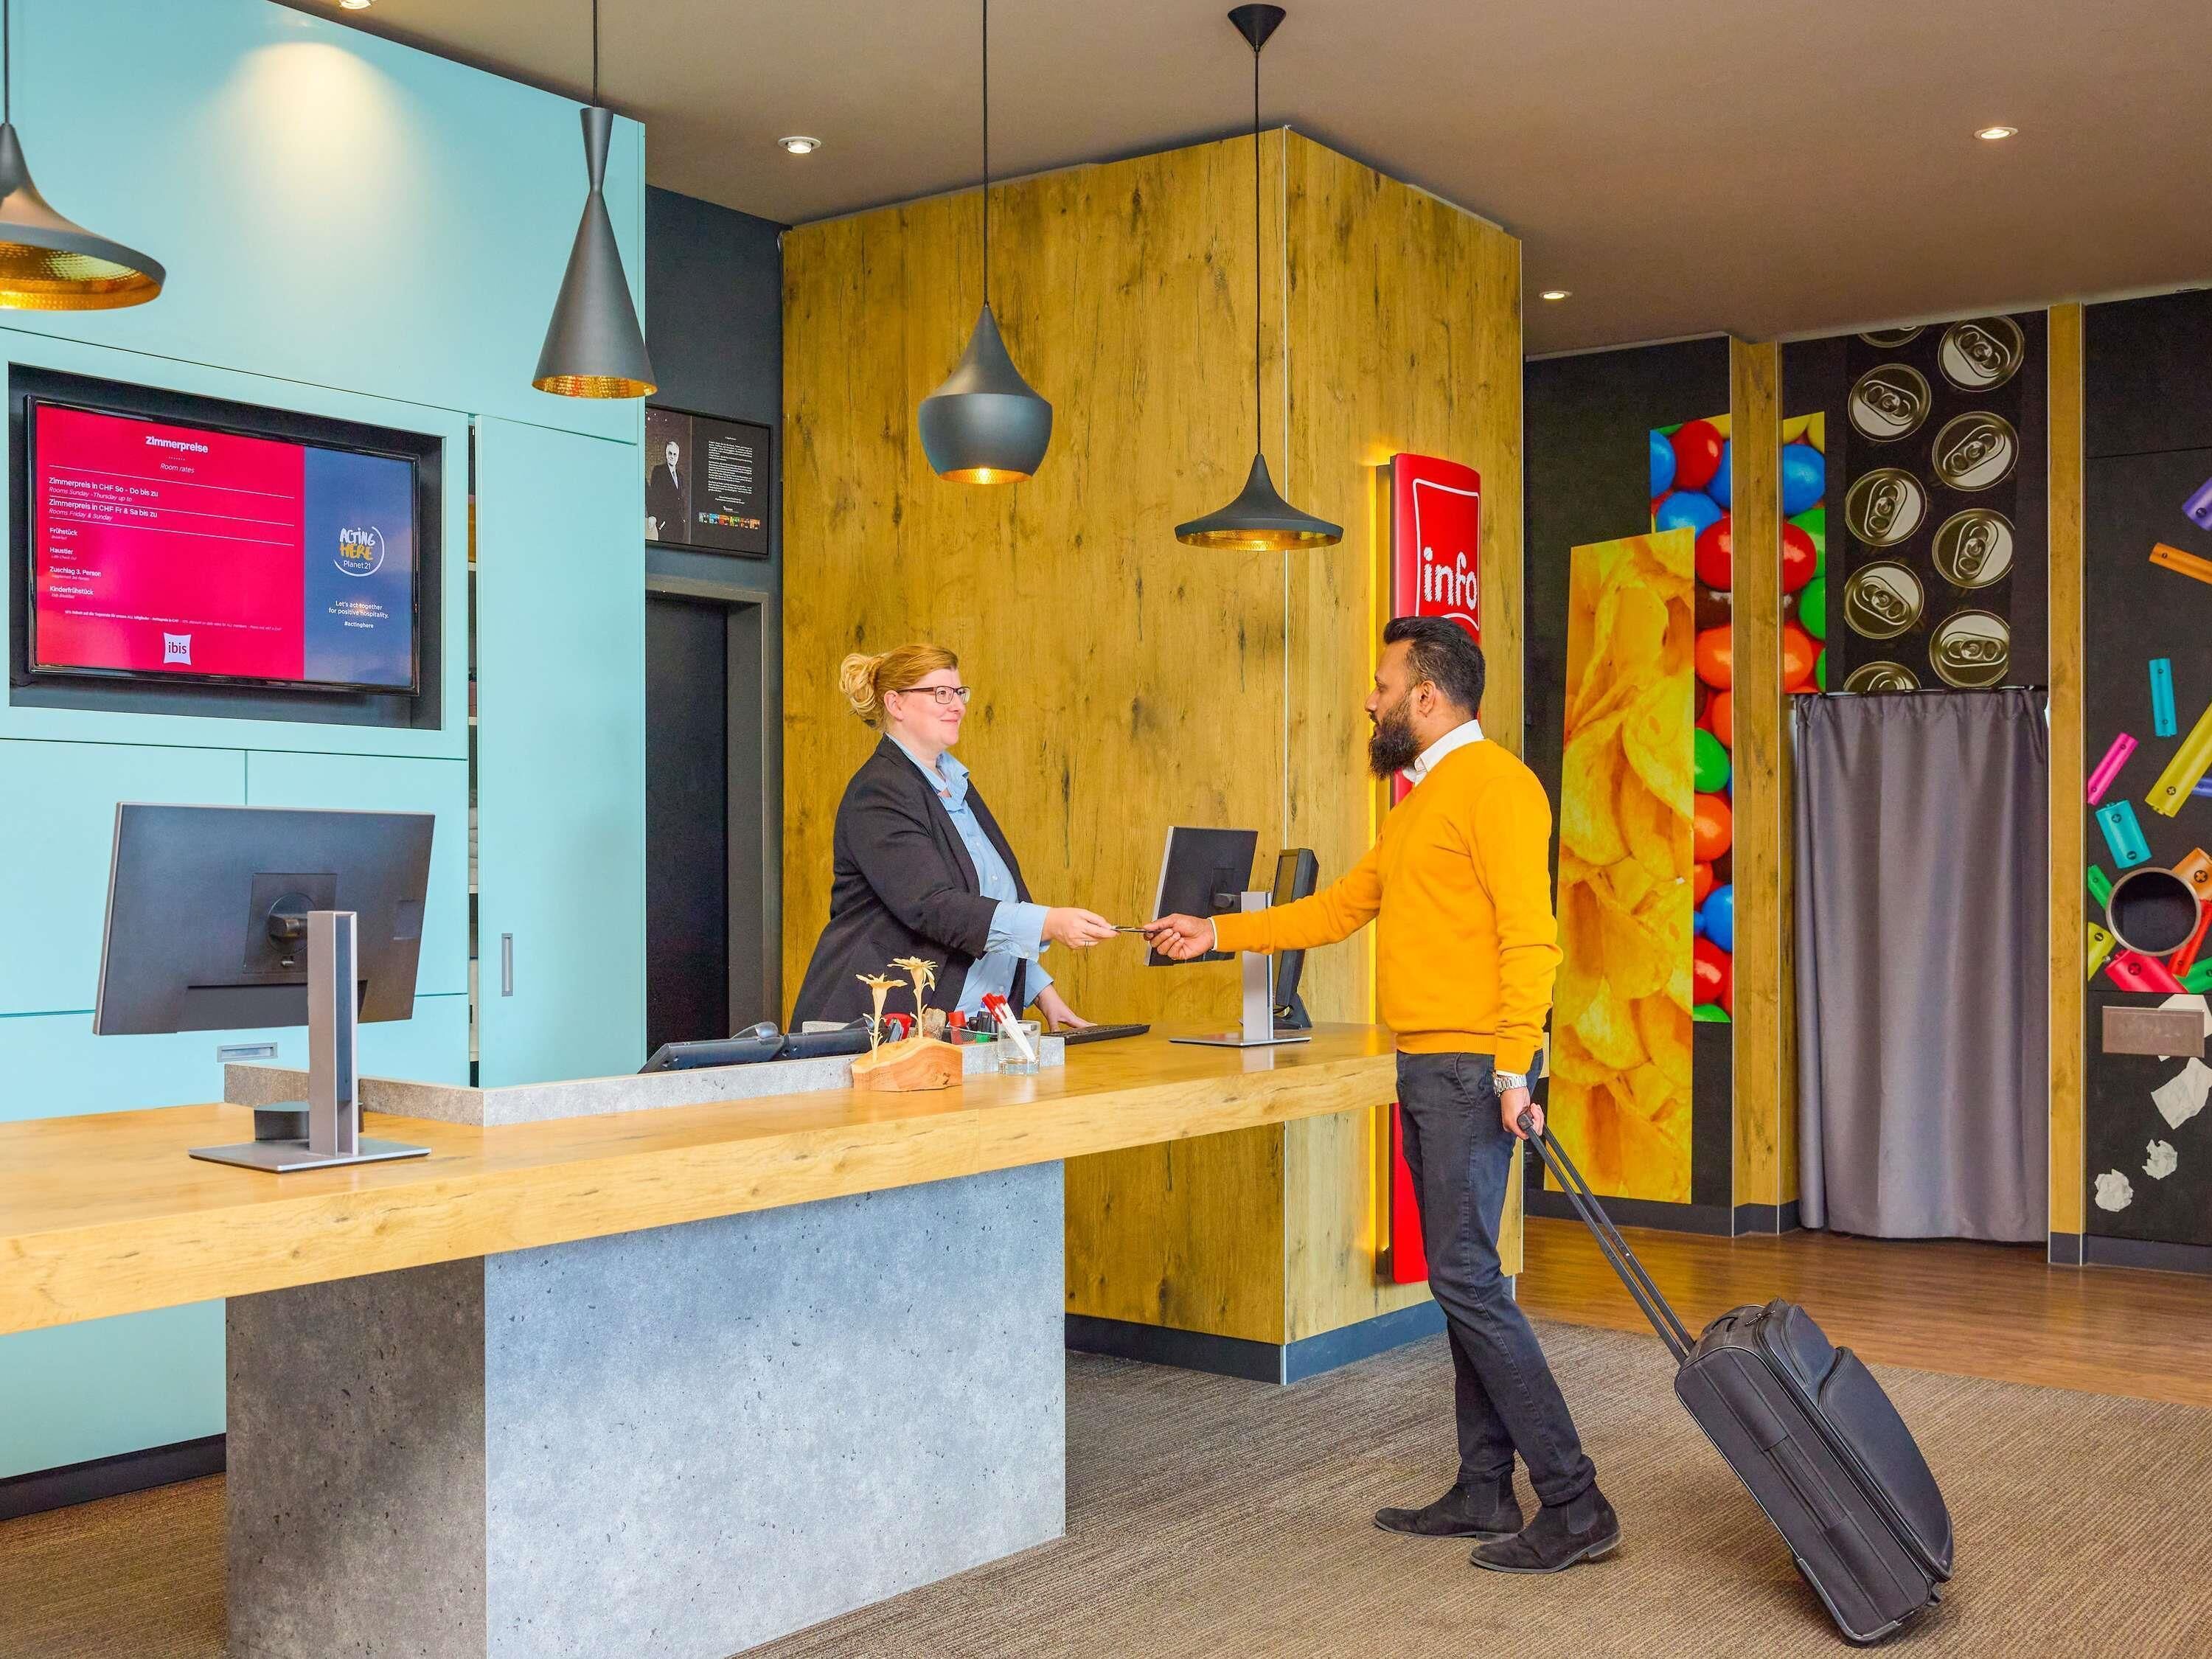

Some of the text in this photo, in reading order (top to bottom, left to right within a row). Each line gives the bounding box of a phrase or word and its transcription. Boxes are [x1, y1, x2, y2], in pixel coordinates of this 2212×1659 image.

[145, 436, 209, 453] Zimmerpreise
[160, 463, 195, 473] Room rates
[49, 477, 91, 488] Zimmerpreis
[140, 488, 150, 496] bis
[69, 489, 89, 497] Sunday
[49, 498, 91, 509] Zimmerpreis
[69, 510, 87, 519] Friday
[93, 513, 113, 522] Sunday
[49, 528, 77, 536] Frühstück
[341, 543, 373, 560] HERE
[50, 566, 74, 575] Zuschlag
[1423, 546, 1478, 611] info
[50, 586, 94, 595] Kinderfrühstück
[338, 608, 359, 616] positive
[168, 641, 187, 654] ibis
